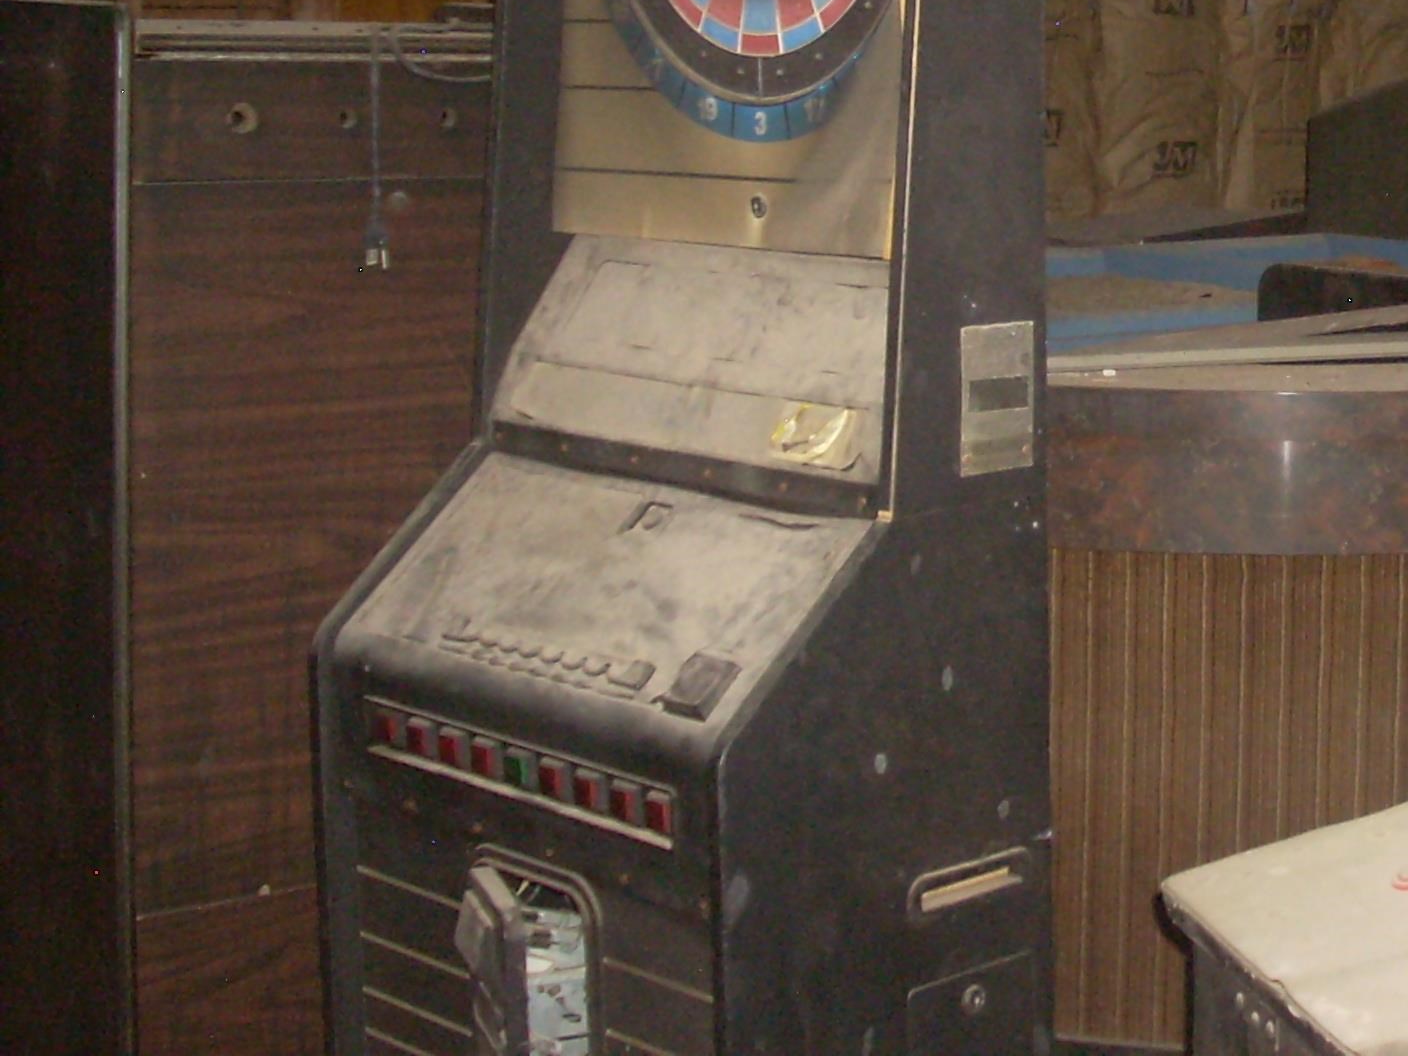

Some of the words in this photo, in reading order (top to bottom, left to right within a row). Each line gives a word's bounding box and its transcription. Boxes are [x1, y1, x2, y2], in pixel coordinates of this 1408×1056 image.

[697, 96, 717, 121] 19
[753, 110, 768, 136] 3
[1154, 141, 1198, 172] JM
